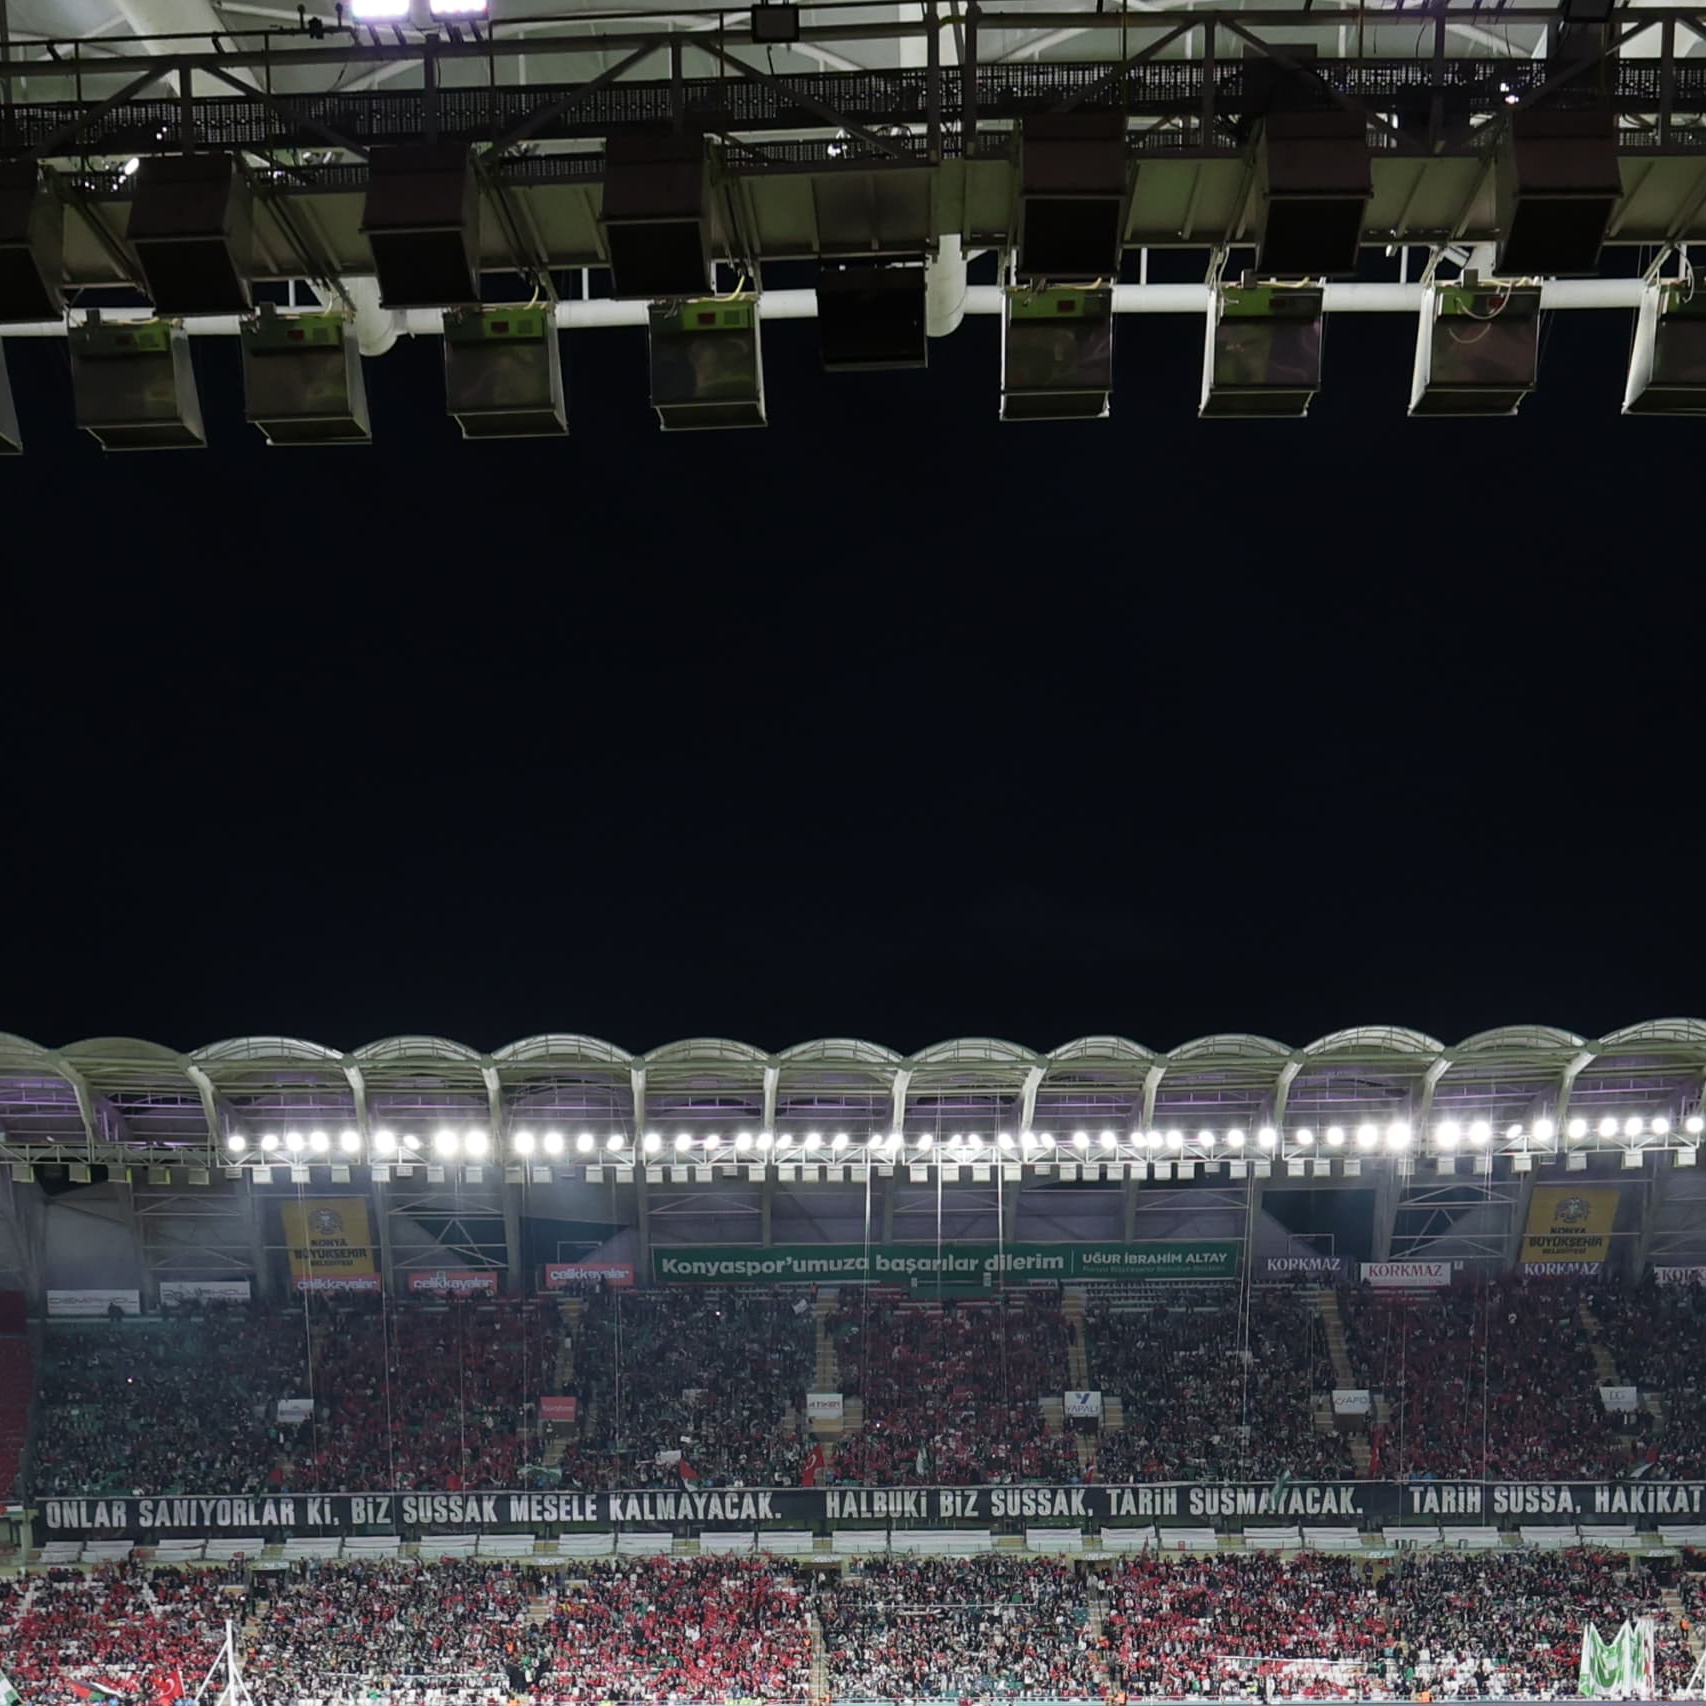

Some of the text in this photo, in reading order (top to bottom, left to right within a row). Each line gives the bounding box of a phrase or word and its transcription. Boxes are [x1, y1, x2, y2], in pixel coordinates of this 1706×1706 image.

[984, 1253, 1064, 1272] dilerim
[1082, 1252, 1121, 1264] UĞUR
[1185, 1252, 1227, 1264] ALTAY
[1267, 1258, 1341, 1272] KORKMAZ
[1368, 1263, 1443, 1277] KORKMAZ
[46, 1501, 127, 1529] ONLAR
[139, 1498, 295, 1527] SANIYORLAR
[403, 1496, 498, 1524] SUSSAK
[510, 1494, 597, 1522] MESELE
[609, 1492, 782, 1521] KALMAYACAK.
